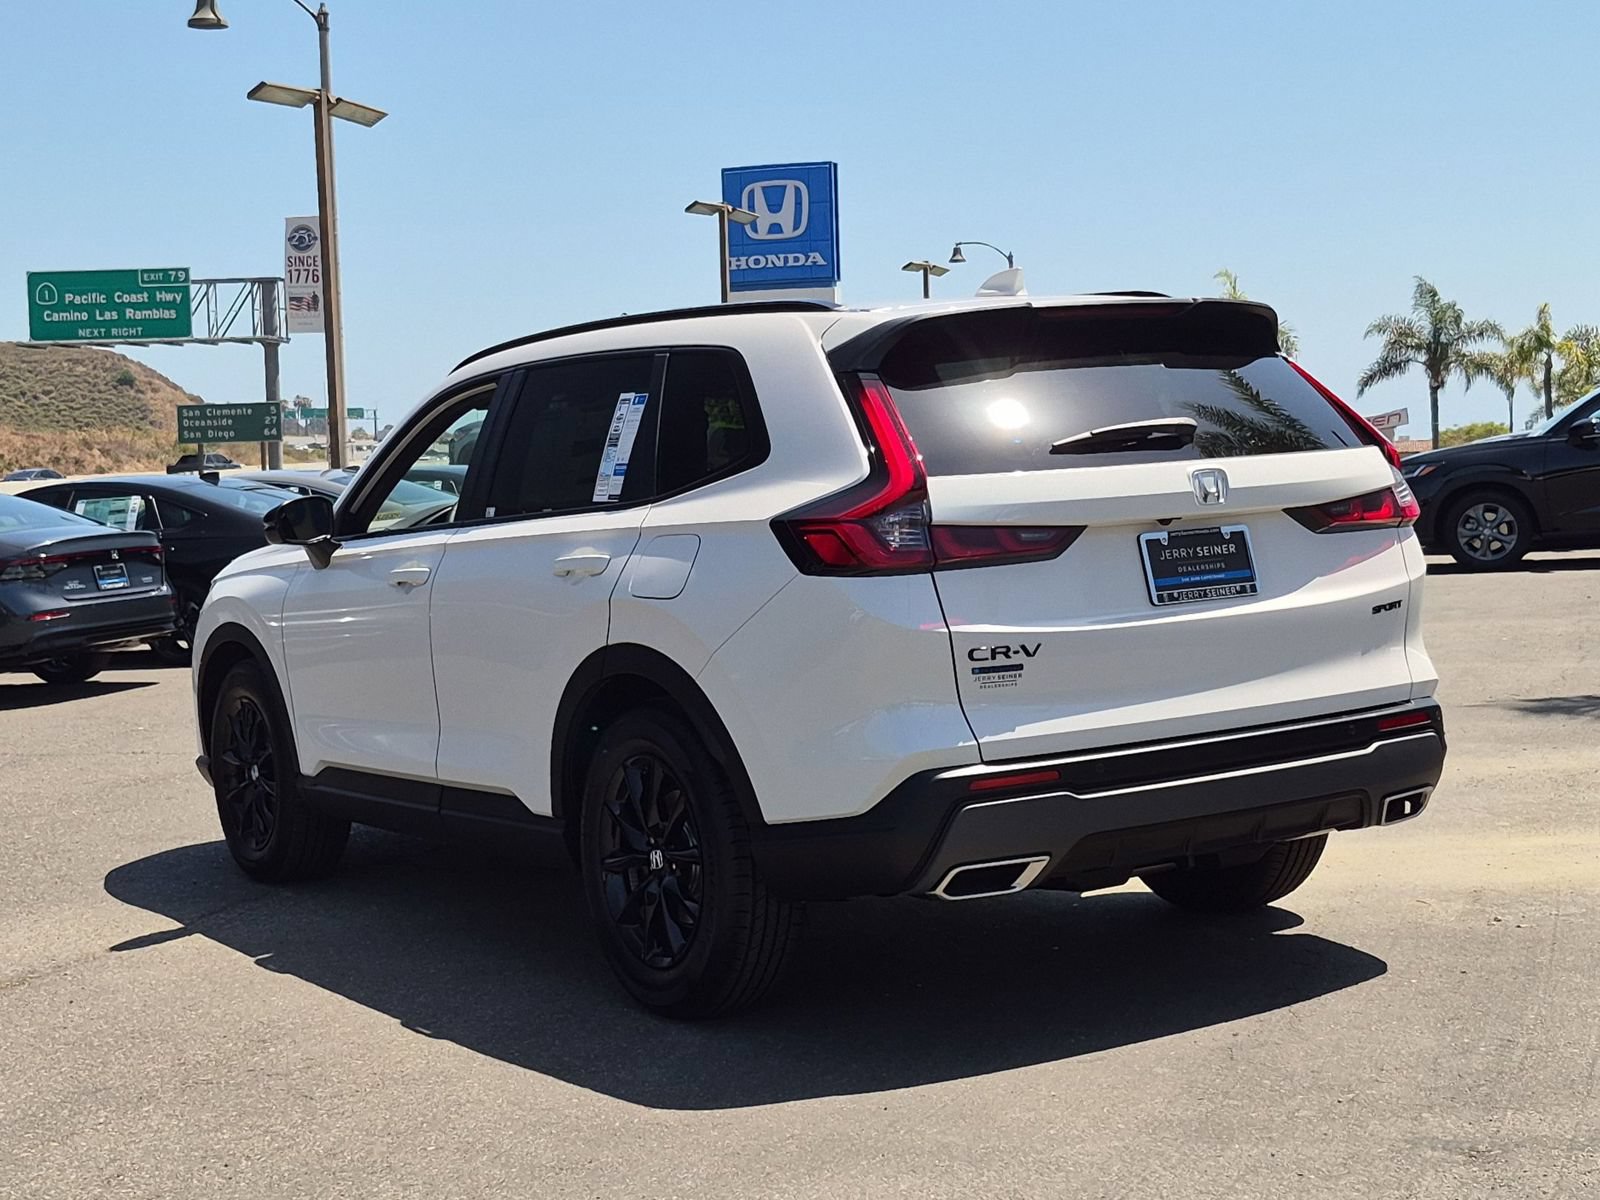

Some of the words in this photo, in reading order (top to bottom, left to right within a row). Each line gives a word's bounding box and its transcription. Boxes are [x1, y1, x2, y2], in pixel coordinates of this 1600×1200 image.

[287, 255, 319, 267] SINCE
[729, 252, 827, 270] HONDA
[143, 273, 163, 281] EXIT
[168, 271, 186, 281] 79
[287, 268, 320, 284] 1776
[44, 290, 49, 300] 1
[64, 293, 107, 304] Pacific
[114, 291, 149, 303] Coast
[156, 290, 182, 304] Hwy
[43, 310, 88, 321] Camino
[95, 310, 118, 320] Las
[125, 308, 176, 320] Ramblas
[78, 328, 106, 337] NEXT
[111, 327, 143, 336] RIGHT
[182, 408, 200, 417] San
[206, 407, 253, 416] Clemente
[270, 405, 277, 414] 5
[183, 417, 233, 427] Oceanside
[264, 416, 278, 425] 27
[183, 430, 202, 439] San
[207, 429, 236, 440] Diego
[263, 427, 278, 436] 64
[1160, 548, 1194, 560] JERRY
[1196, 543, 1237, 557] SEINER
[1177, 562, 1226, 573] DEALERSHIPS
[1178, 589, 1205, 601] JERRY
[1205, 586, 1237, 598] SEINER
[1372, 600, 1403, 614] SPORT
[967, 643, 1042, 662] CR-V
